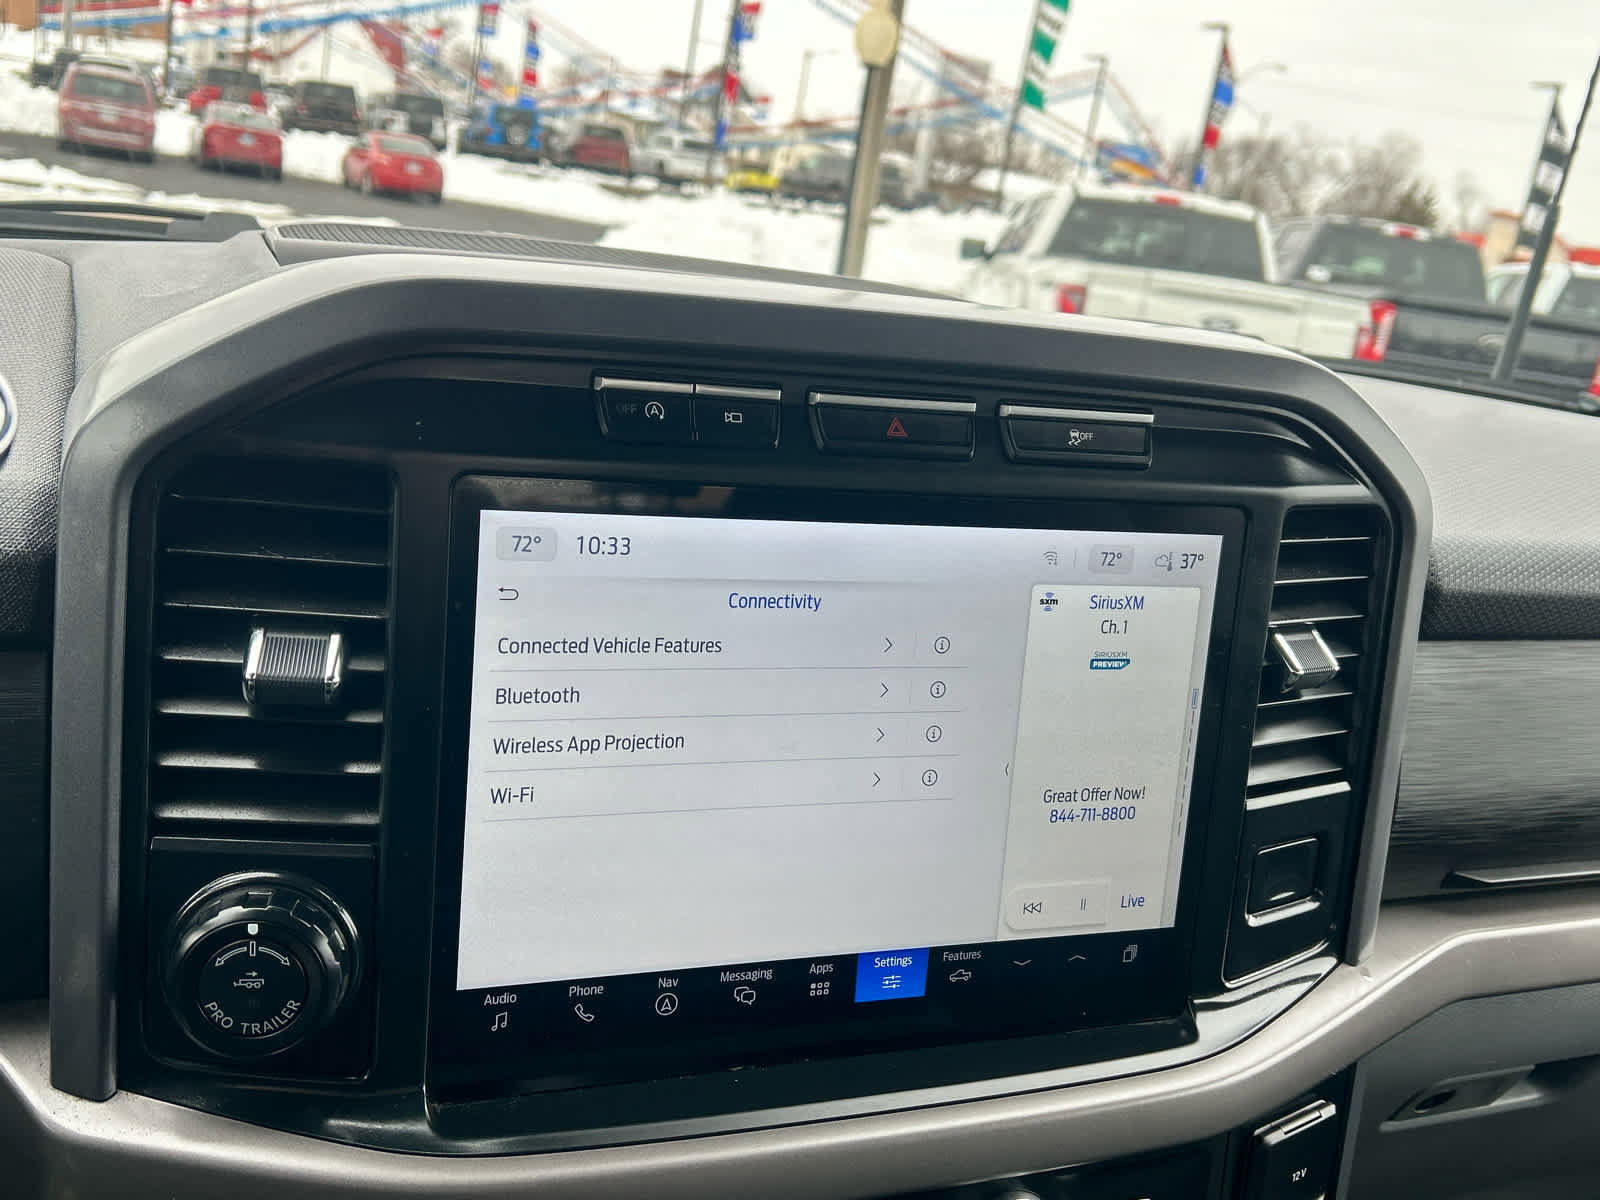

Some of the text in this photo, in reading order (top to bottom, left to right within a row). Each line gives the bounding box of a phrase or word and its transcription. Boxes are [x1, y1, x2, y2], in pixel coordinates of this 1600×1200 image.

[1080, 432, 1094, 441] OFF
[576, 535, 632, 556] 10:33
[728, 592, 822, 612] Connectivity
[1089, 594, 1145, 611] SiriusXM
[1100, 619, 1128, 635] Ch. 1
[497, 637, 723, 655] Connected Vehicle Features
[1094, 650, 1128, 658] SIRIUSXM
[495, 686, 580, 705] Bluetooth
[492, 733, 686, 755] Wireless App Projection
[490, 786, 535, 805] Wi-Fi
[1043, 785, 1146, 804] Great Offer Now!
[1049, 806, 1136, 824] 844-711-8800
[1120, 894, 1145, 909] Live
[874, 955, 913, 969] Settings
[943, 950, 982, 963] Features
[720, 967, 773, 984] Messaging
[809, 961, 834, 975] Apps
[568, 983, 604, 998] Phone
[658, 976, 679, 990] Nav
[483, 992, 517, 1006] Audio
[204, 1000, 302, 1036] PRO TRAILER
